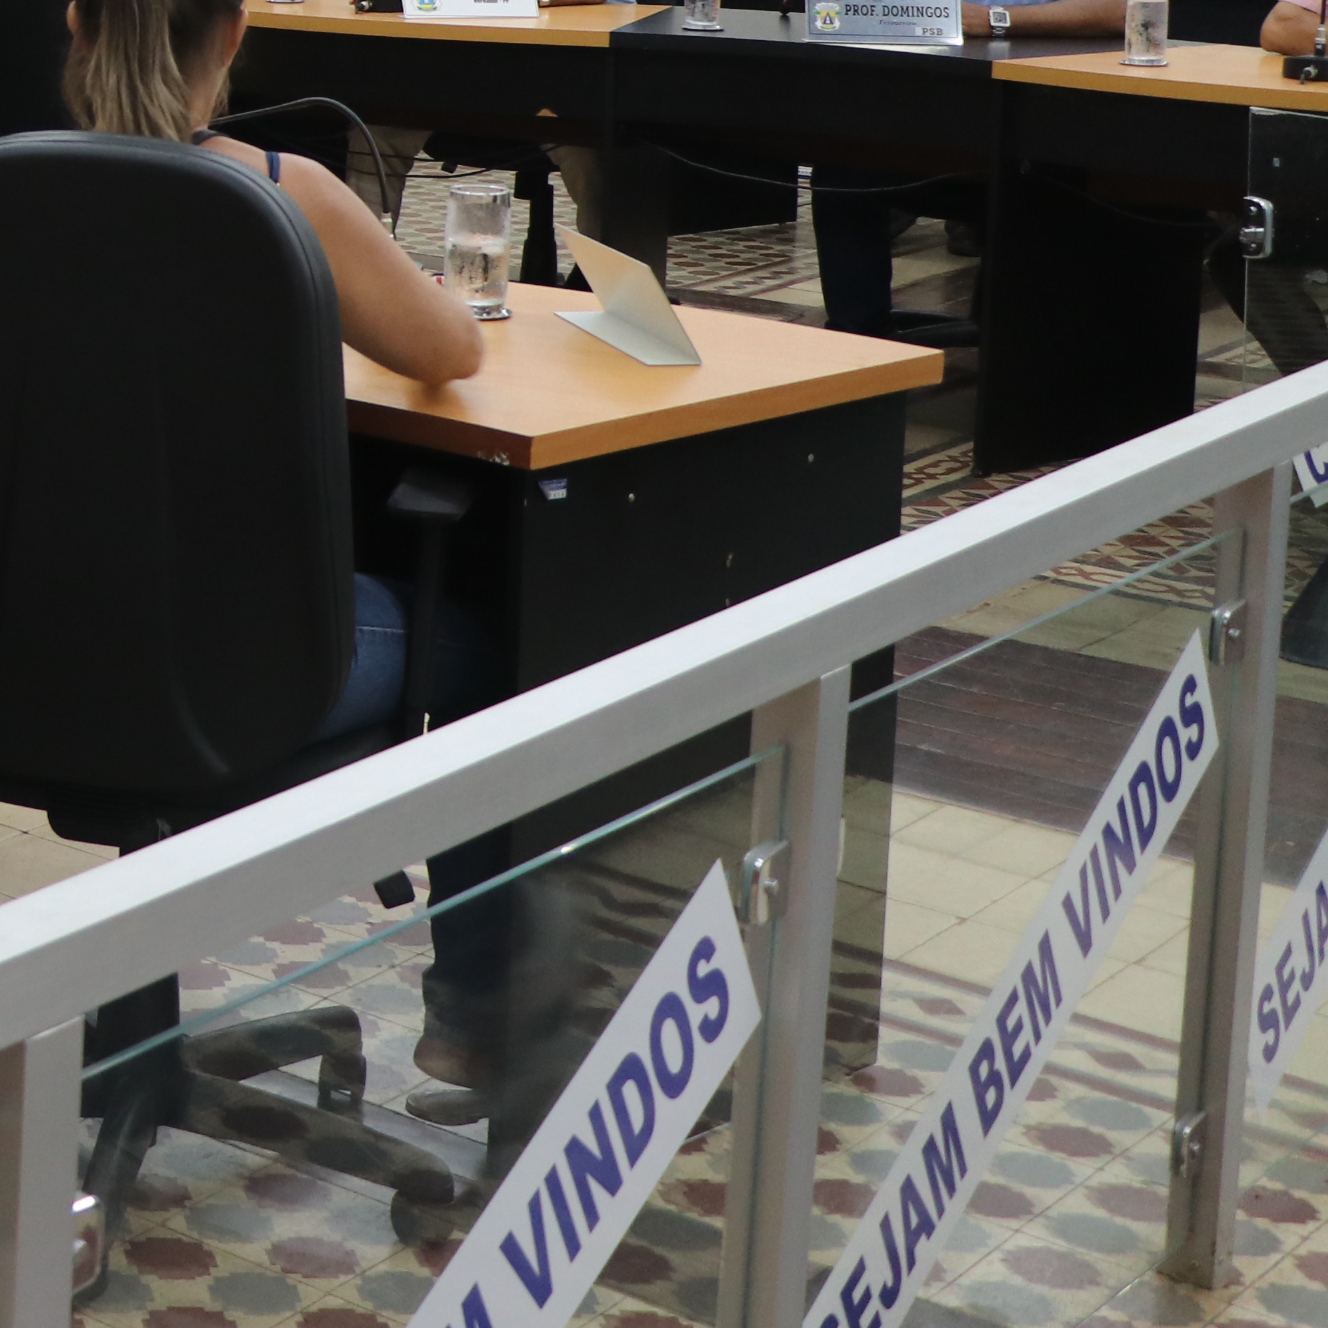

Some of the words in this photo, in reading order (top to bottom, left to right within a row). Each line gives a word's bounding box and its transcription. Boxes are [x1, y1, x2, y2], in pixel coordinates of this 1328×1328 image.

[845, 4, 879, 17] PROF.
[882, 5, 950, 18] DOMINGOS
[820, 1100, 968, 1328] EJAM
[967, 929, 1063, 1139] BEM
[1062, 673, 1205, 959] VINDOS
[1257, 880, 1328, 1063] SEJA
[499, 935, 731, 1310] VINDOS
